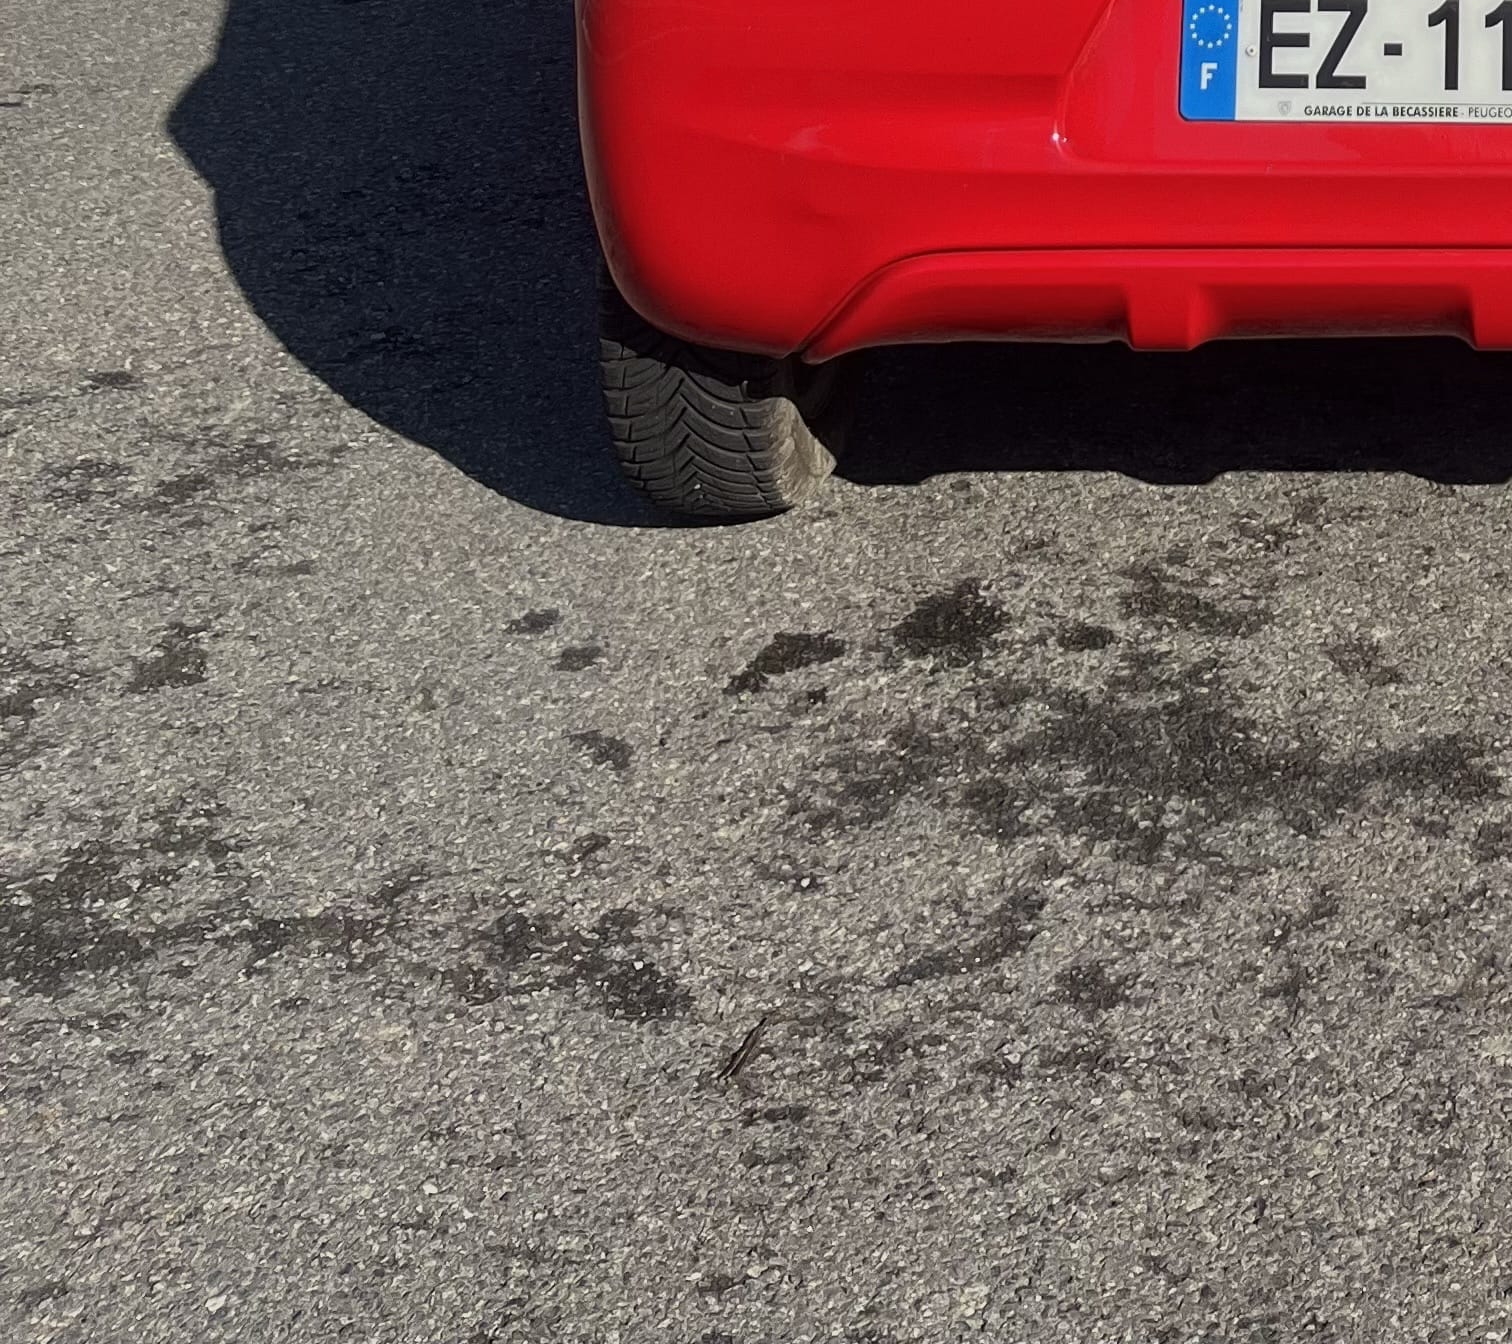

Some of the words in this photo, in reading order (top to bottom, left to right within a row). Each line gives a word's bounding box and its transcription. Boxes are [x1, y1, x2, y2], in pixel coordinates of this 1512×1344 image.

[1200, 62, 1218, 90] F
[1303, 105, 1353, 117] GARAGE
[1356, 105, 1371, 117] DE
[1374, 106, 1389, 117] LA
[1392, 106, 1459, 118] BECASSIERE
